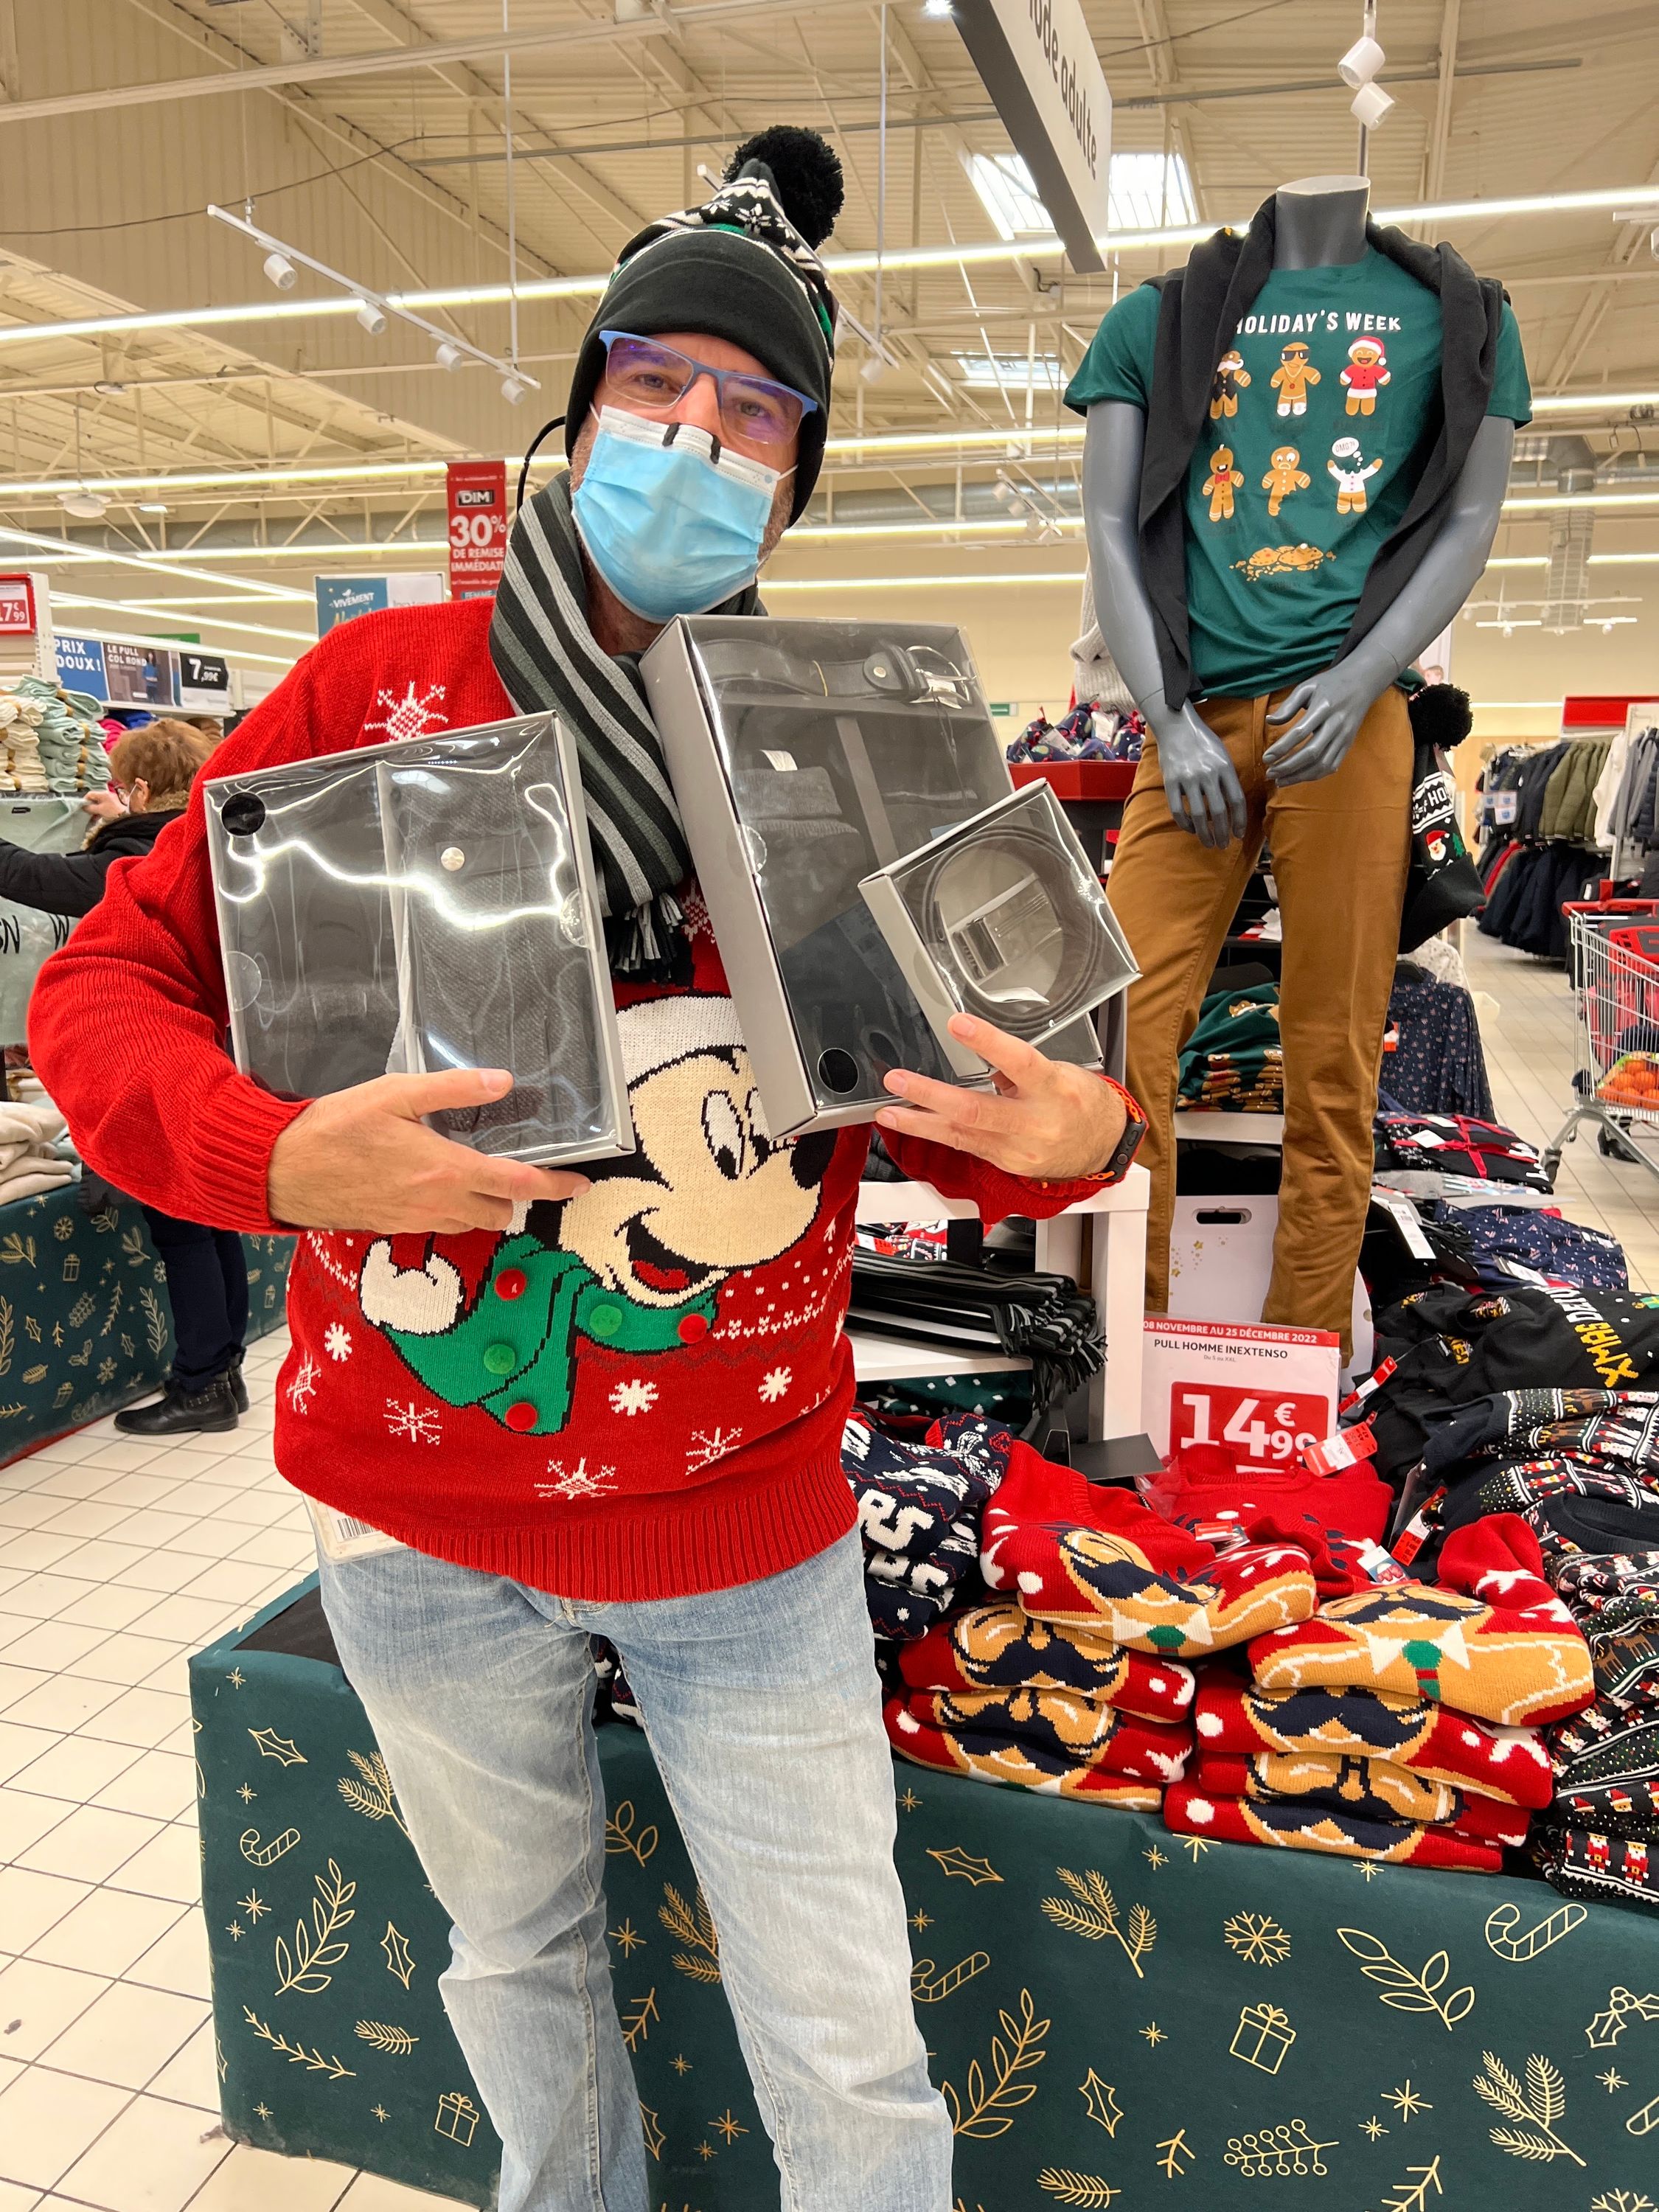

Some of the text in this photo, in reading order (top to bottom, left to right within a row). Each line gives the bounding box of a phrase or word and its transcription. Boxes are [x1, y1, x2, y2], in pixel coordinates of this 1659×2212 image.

[1029, 0, 1097, 181] ode adulte
[1346, 312, 1402, 331] WEEK
[461, 491, 490, 504] DIM
[453, 547, 505, 558] DE REMISE
[451, 558, 504, 572] IMMÉDIAT
[333, 592, 375, 608] VIVEMENT
[0, 602, 13, 622] 7
[54, 639, 86, 655] PRIX
[107, 644, 139, 656] LE PULL
[108, 653, 125, 664] COL
[125, 656, 147, 667] ROND
[1156, 1321, 1208, 1335] NOVEMBRE
[1209, 1326, 1224, 1336] AU
[1225, 1328, 1237, 1337] 25
[1239, 1326, 1290, 1341] DÉCEMBRE
[1292, 1333, 1318, 1344] 2022
[1154, 1339, 1288, 1359] PULL HOMME INEXTENSO
[1574, 1321, 1640, 1388] XMAS
